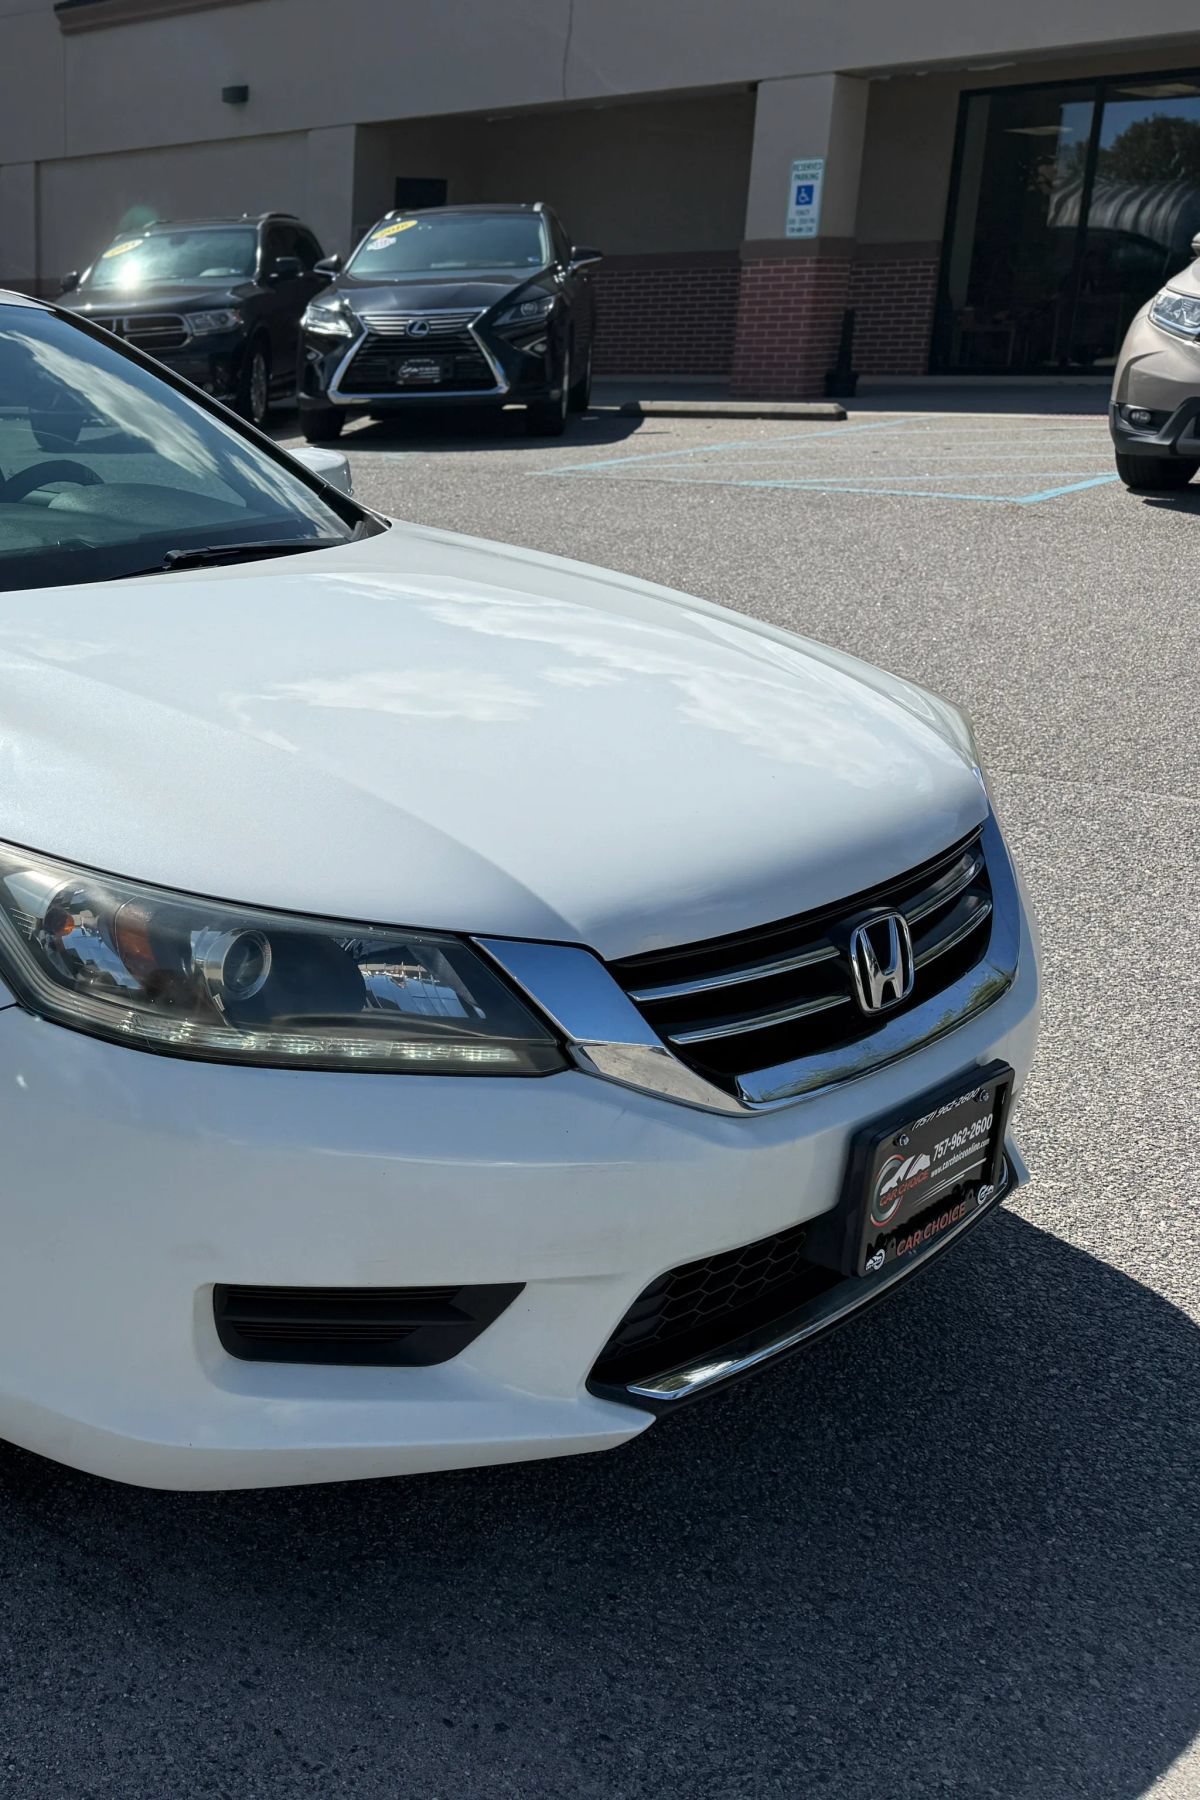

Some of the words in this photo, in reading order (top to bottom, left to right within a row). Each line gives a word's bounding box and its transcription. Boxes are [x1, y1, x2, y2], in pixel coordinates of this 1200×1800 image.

[933, 1113, 993, 1162] 757-962-2600
[879, 1187, 898, 1207] CAR
[896, 1229, 922, 1256] CAR
[924, 1202, 966, 1239] CHOICE
